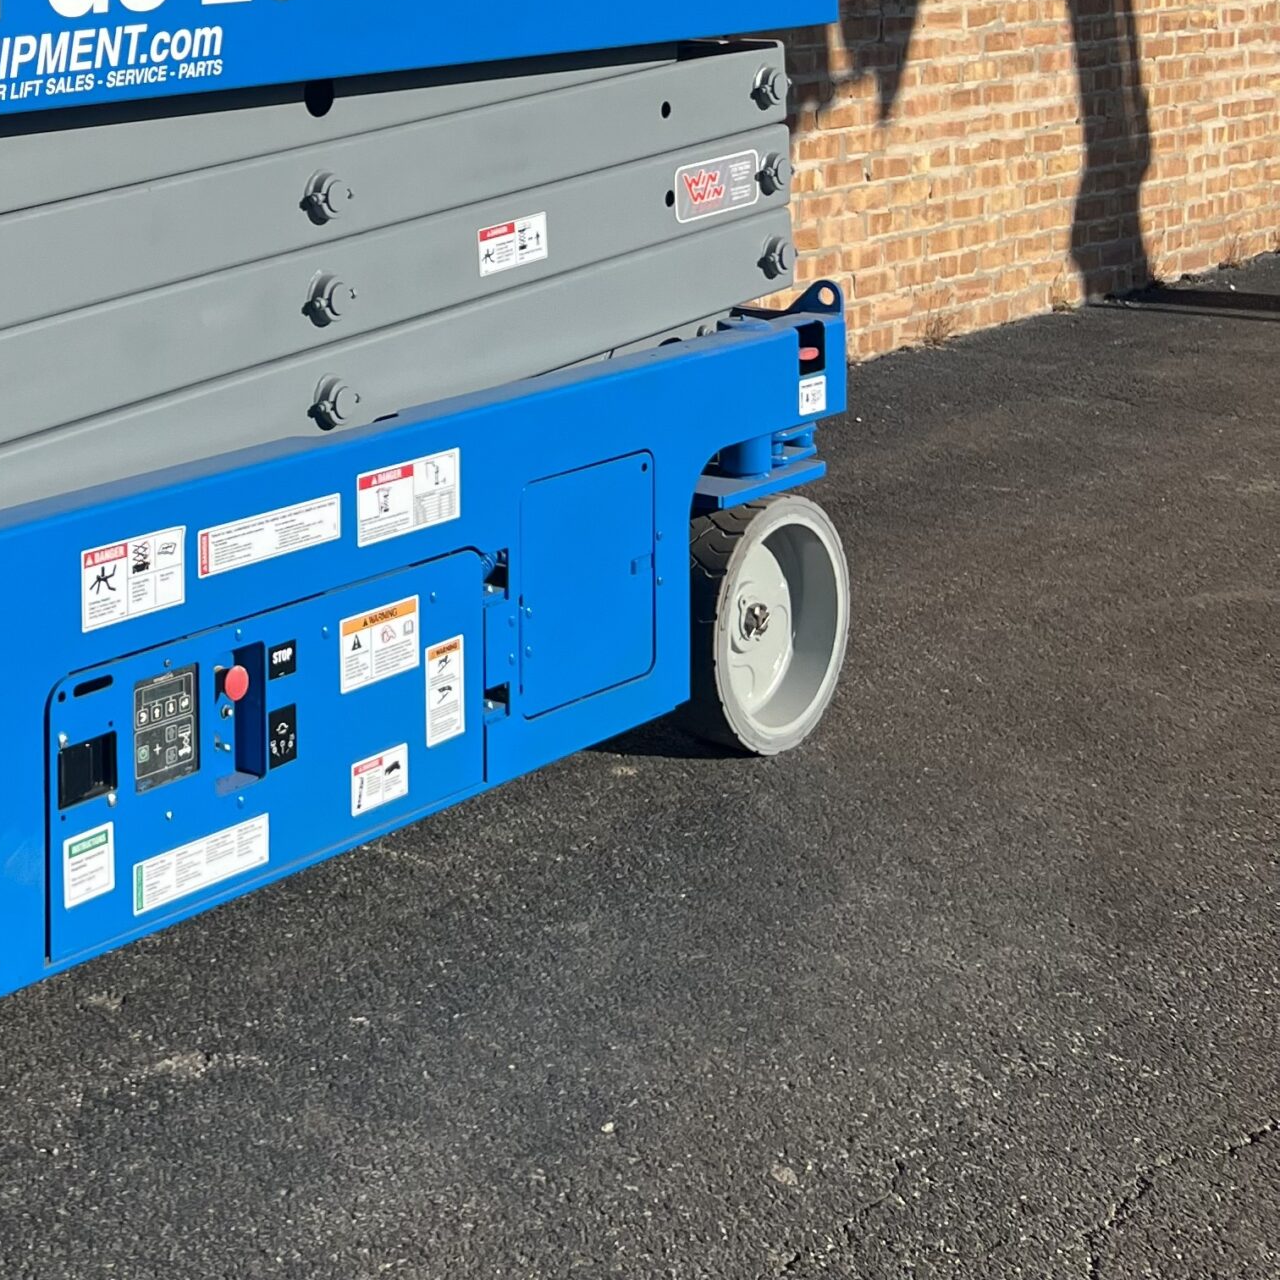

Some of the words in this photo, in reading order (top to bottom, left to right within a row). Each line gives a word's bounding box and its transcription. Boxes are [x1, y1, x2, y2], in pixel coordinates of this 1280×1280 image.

[10, 80, 43, 100] LIFT
[45, 73, 95, 95] SALES
[106, 65, 168, 88] SERVICE
[178, 59, 223, 80] PARTS
[94, 545, 124, 566] DANGER
[369, 608, 398, 625] WARNING
[272, 647, 293, 664] STOP
